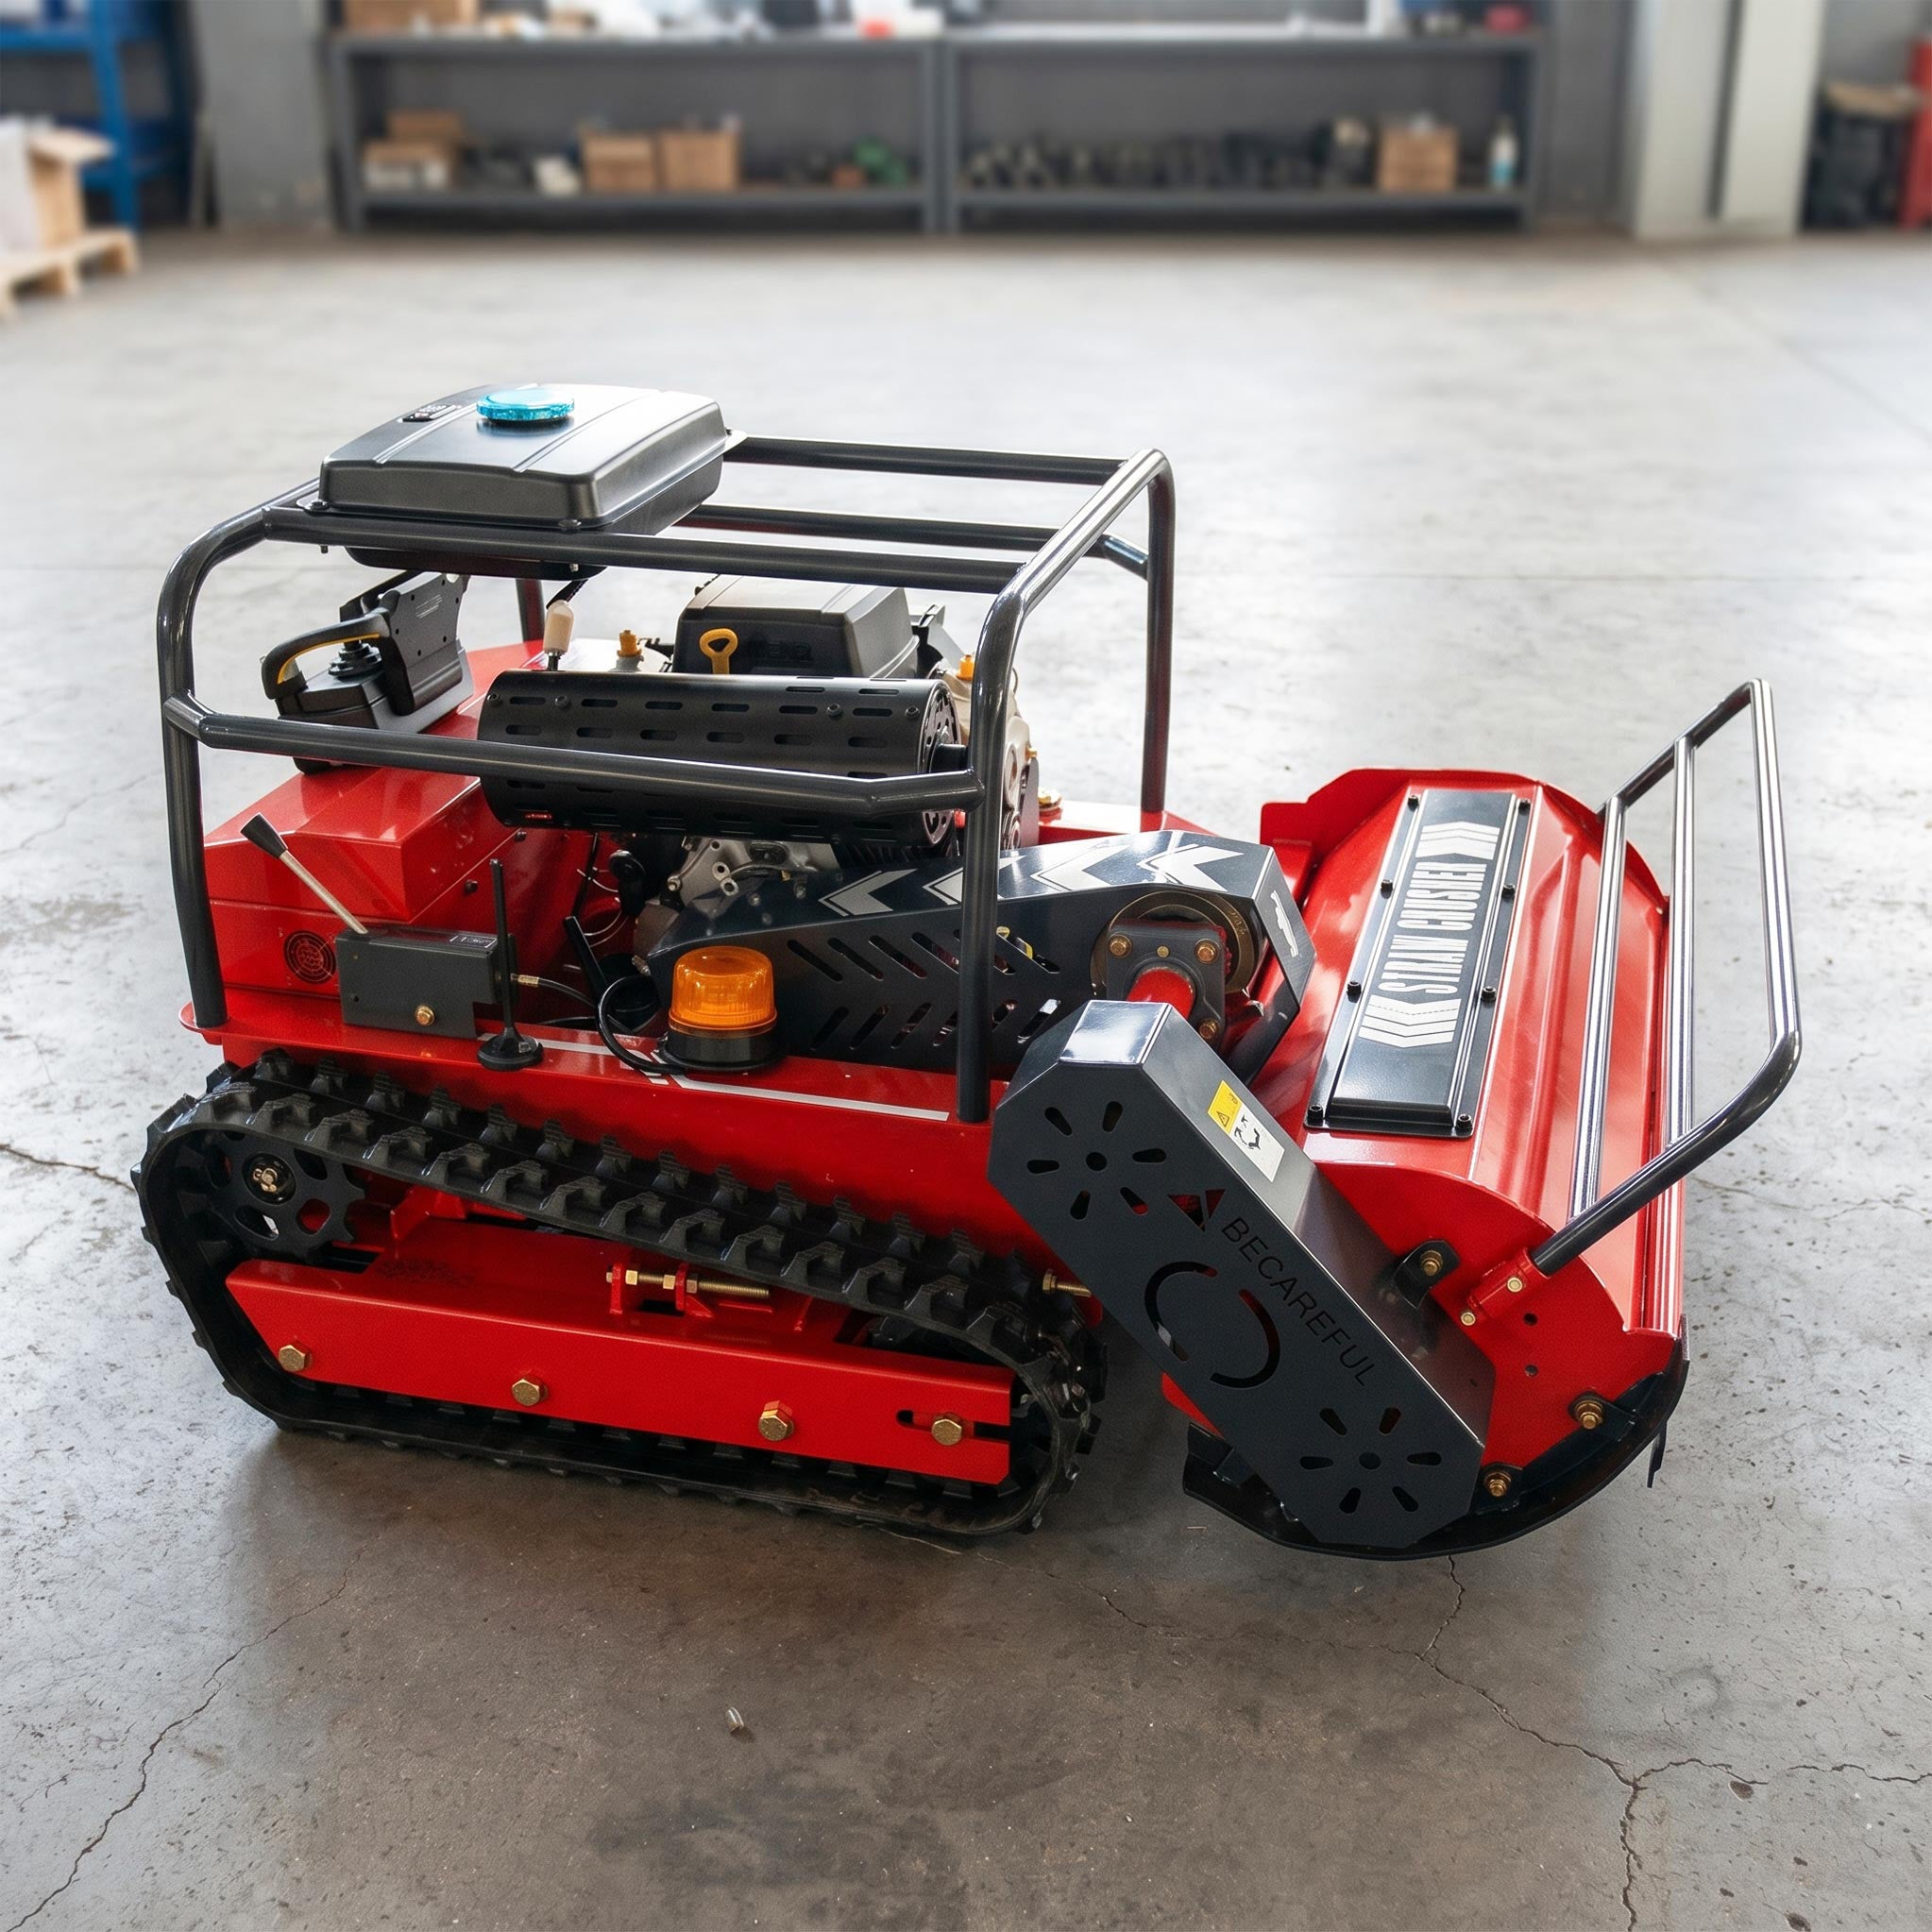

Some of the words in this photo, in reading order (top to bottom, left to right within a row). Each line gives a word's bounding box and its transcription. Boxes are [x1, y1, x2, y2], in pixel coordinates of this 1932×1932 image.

[1398, 862, 1487, 930] CRUSHER
[1379, 935, 1468, 994] STRAW
[1223, 1217, 1380, 1385] BECAREFUL
